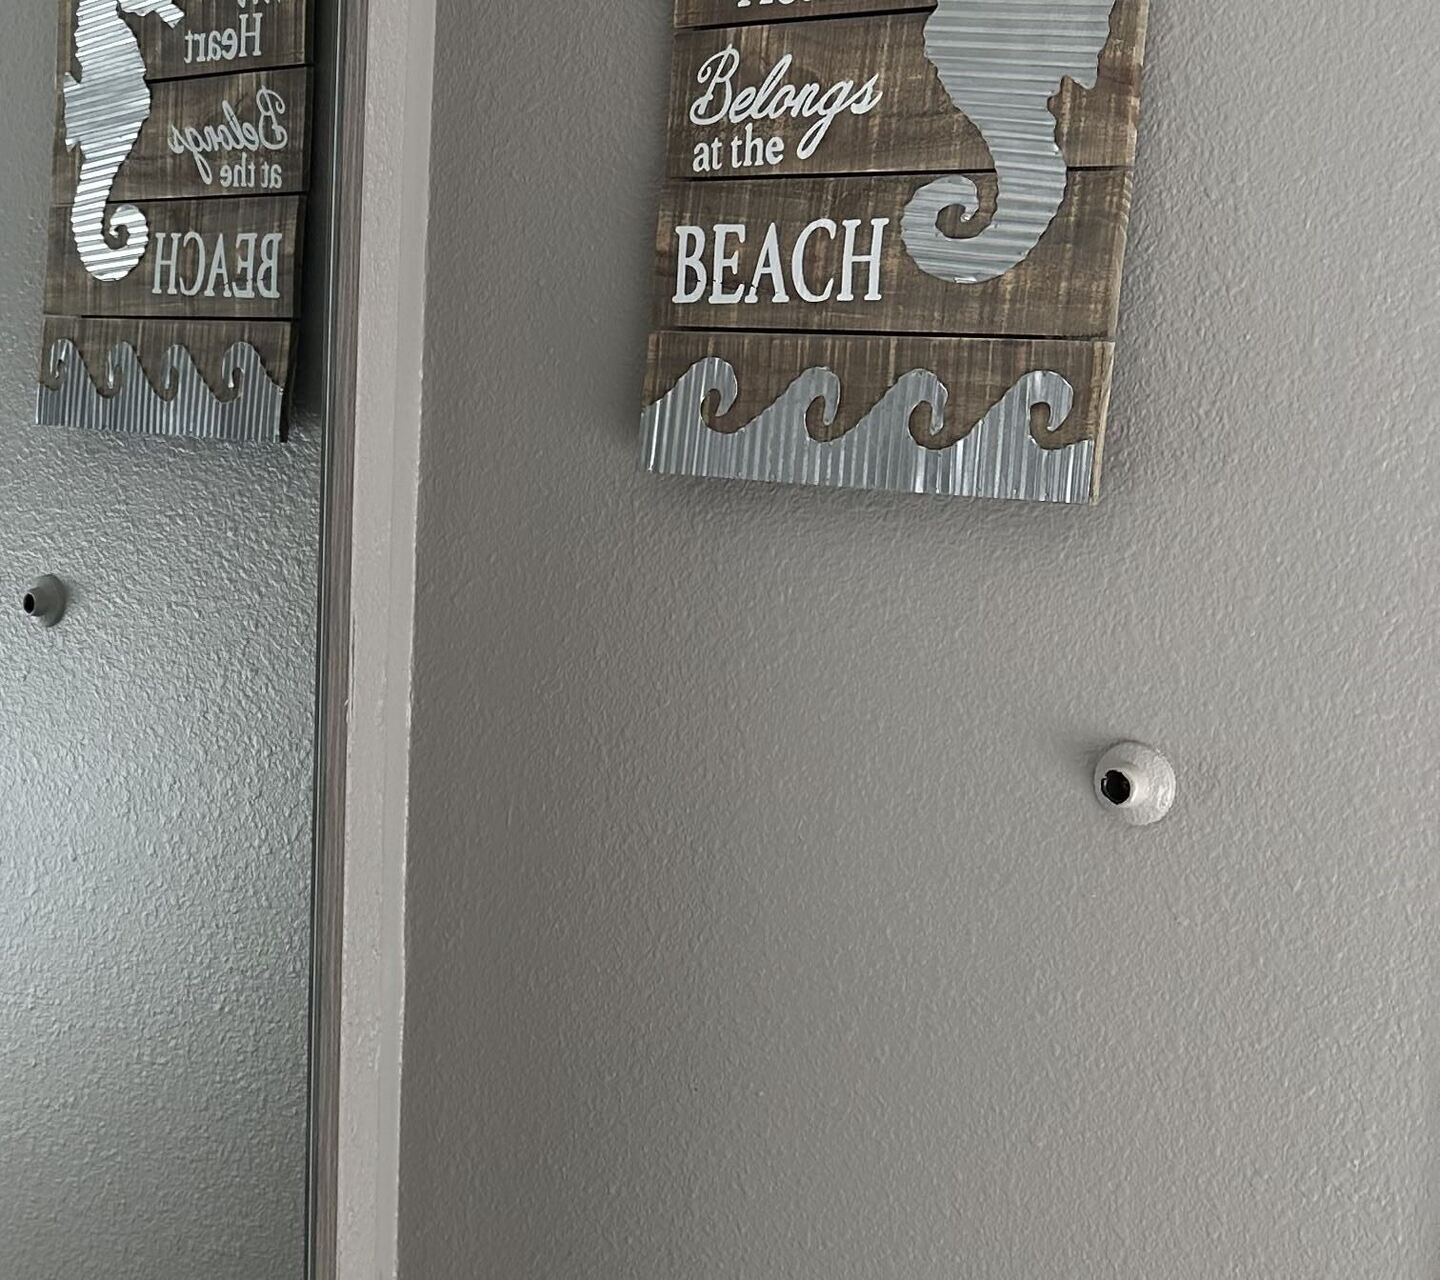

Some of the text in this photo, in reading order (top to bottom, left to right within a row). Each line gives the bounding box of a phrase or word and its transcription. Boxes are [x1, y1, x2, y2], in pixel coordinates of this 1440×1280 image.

[689, 43, 883, 160] Belongs
[692, 123, 785, 173] at the
[672, 218, 890, 305] BEACH
